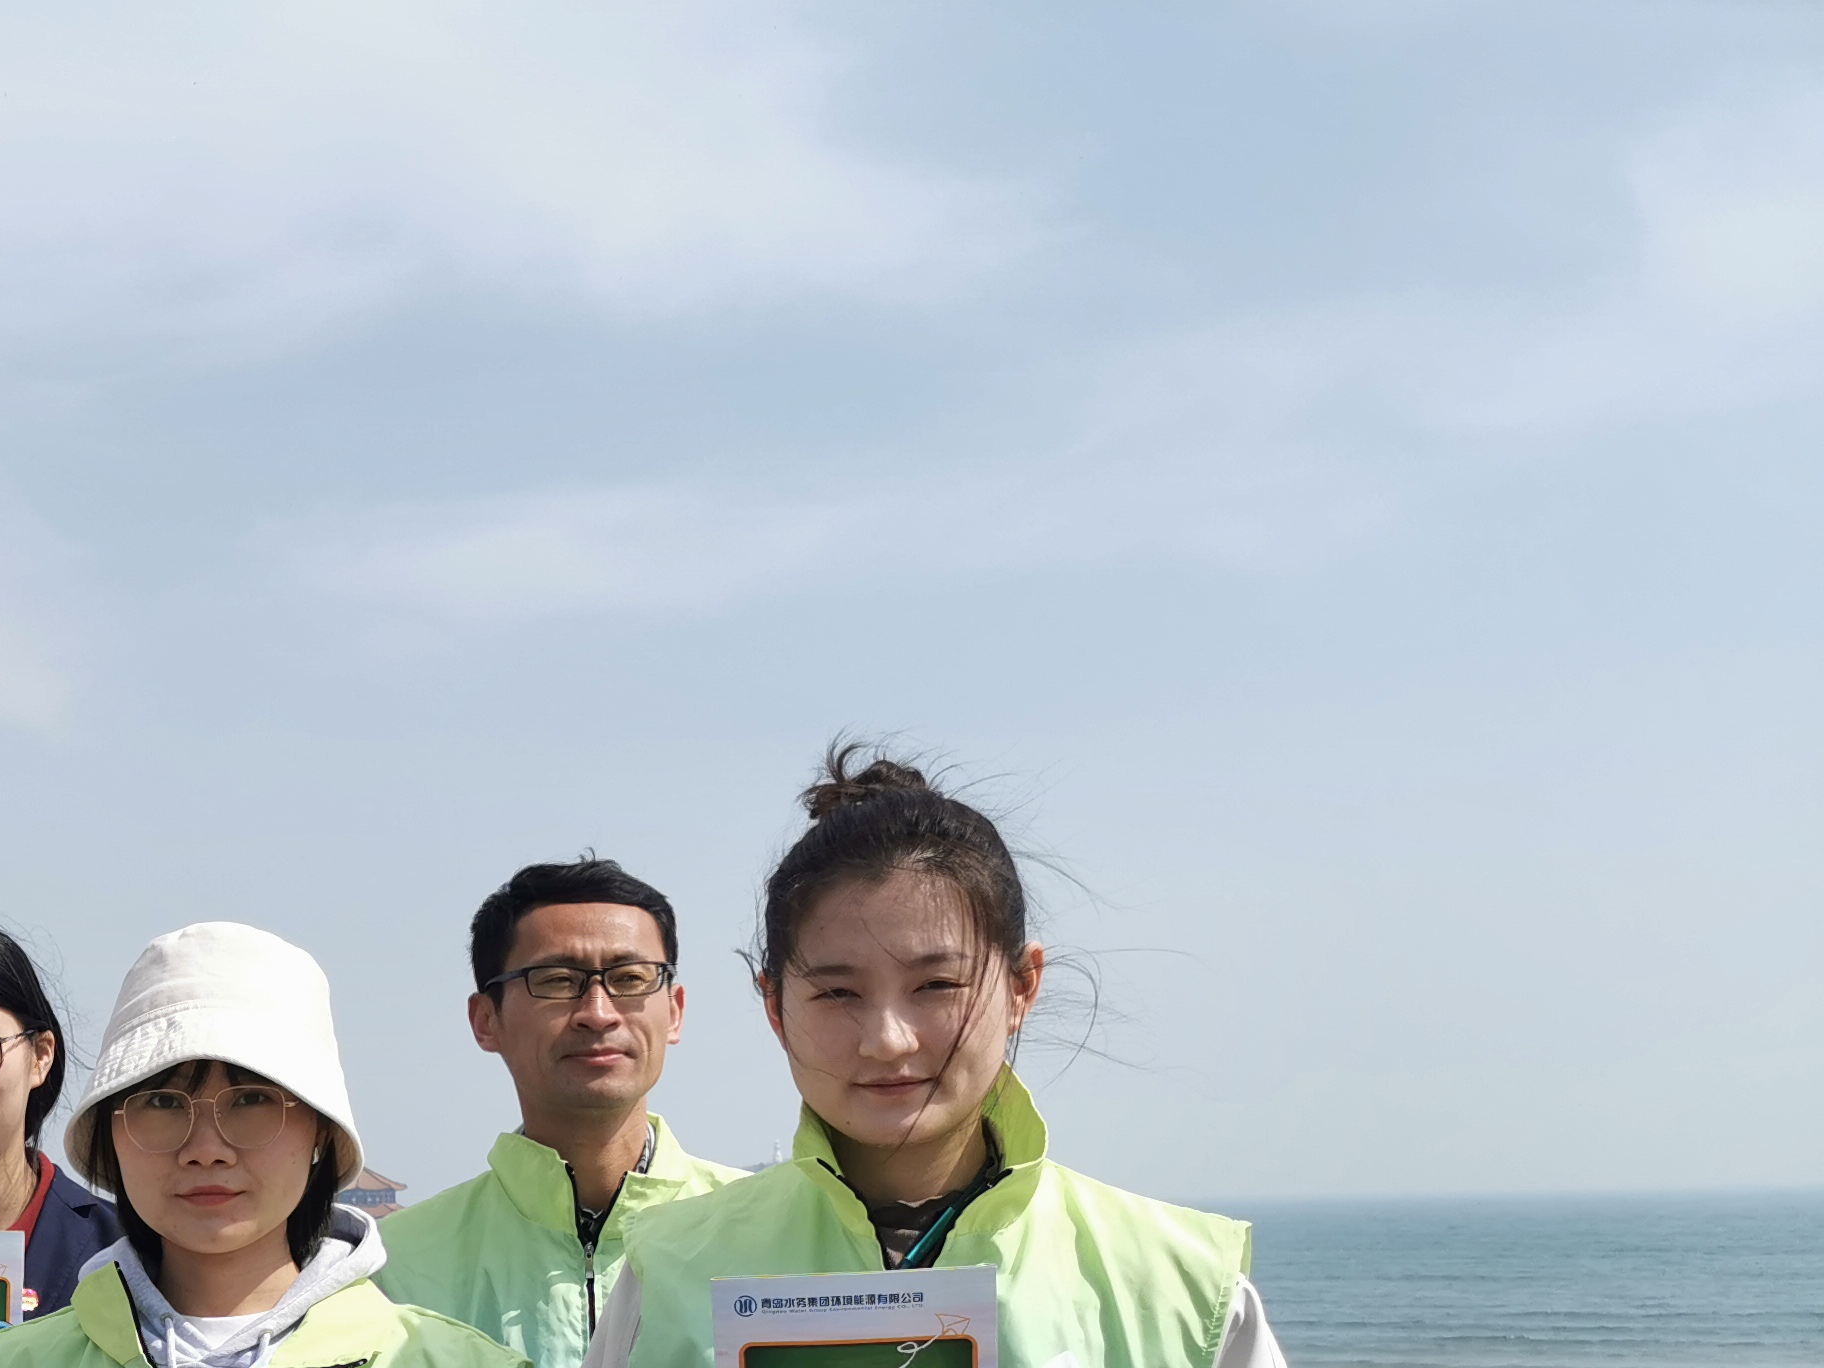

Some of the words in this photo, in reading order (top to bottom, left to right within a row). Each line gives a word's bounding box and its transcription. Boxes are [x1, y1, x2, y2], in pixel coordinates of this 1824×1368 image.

[761, 1291, 924, 1310] 青岛水务集团环境能源有限公司
